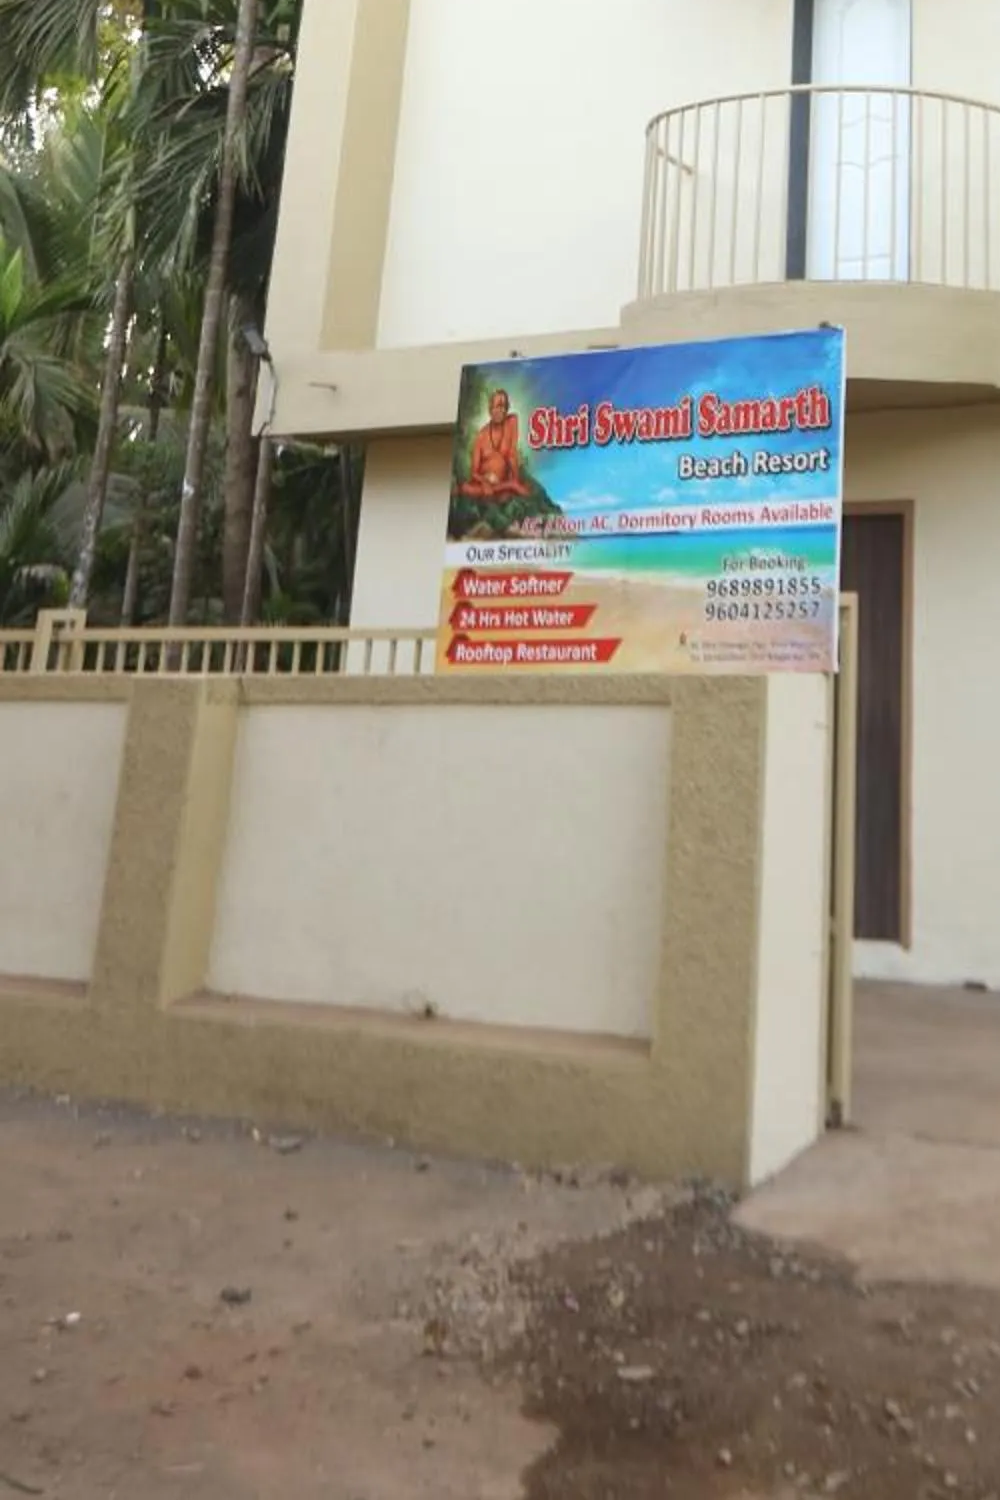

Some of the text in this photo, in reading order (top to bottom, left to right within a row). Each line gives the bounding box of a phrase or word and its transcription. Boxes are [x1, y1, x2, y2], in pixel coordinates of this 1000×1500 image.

[528, 387, 830, 448] Shri Swami Samarth
[678, 447, 828, 480] Beach Resort
[618, 510, 696, 533] Dormitory
[701, 506, 755, 525] Rooms
[759, 501, 832, 522] Available
[723, 555, 805, 572] For Booking
[463, 576, 563, 596] Water Softner
[707, 577, 821, 597] 9689891855
[459, 607, 574, 628] 24 Hrs Hot Water
[705, 602, 819, 621] 9604125257
[456, 642, 597, 665] Rooftop Restaurant
